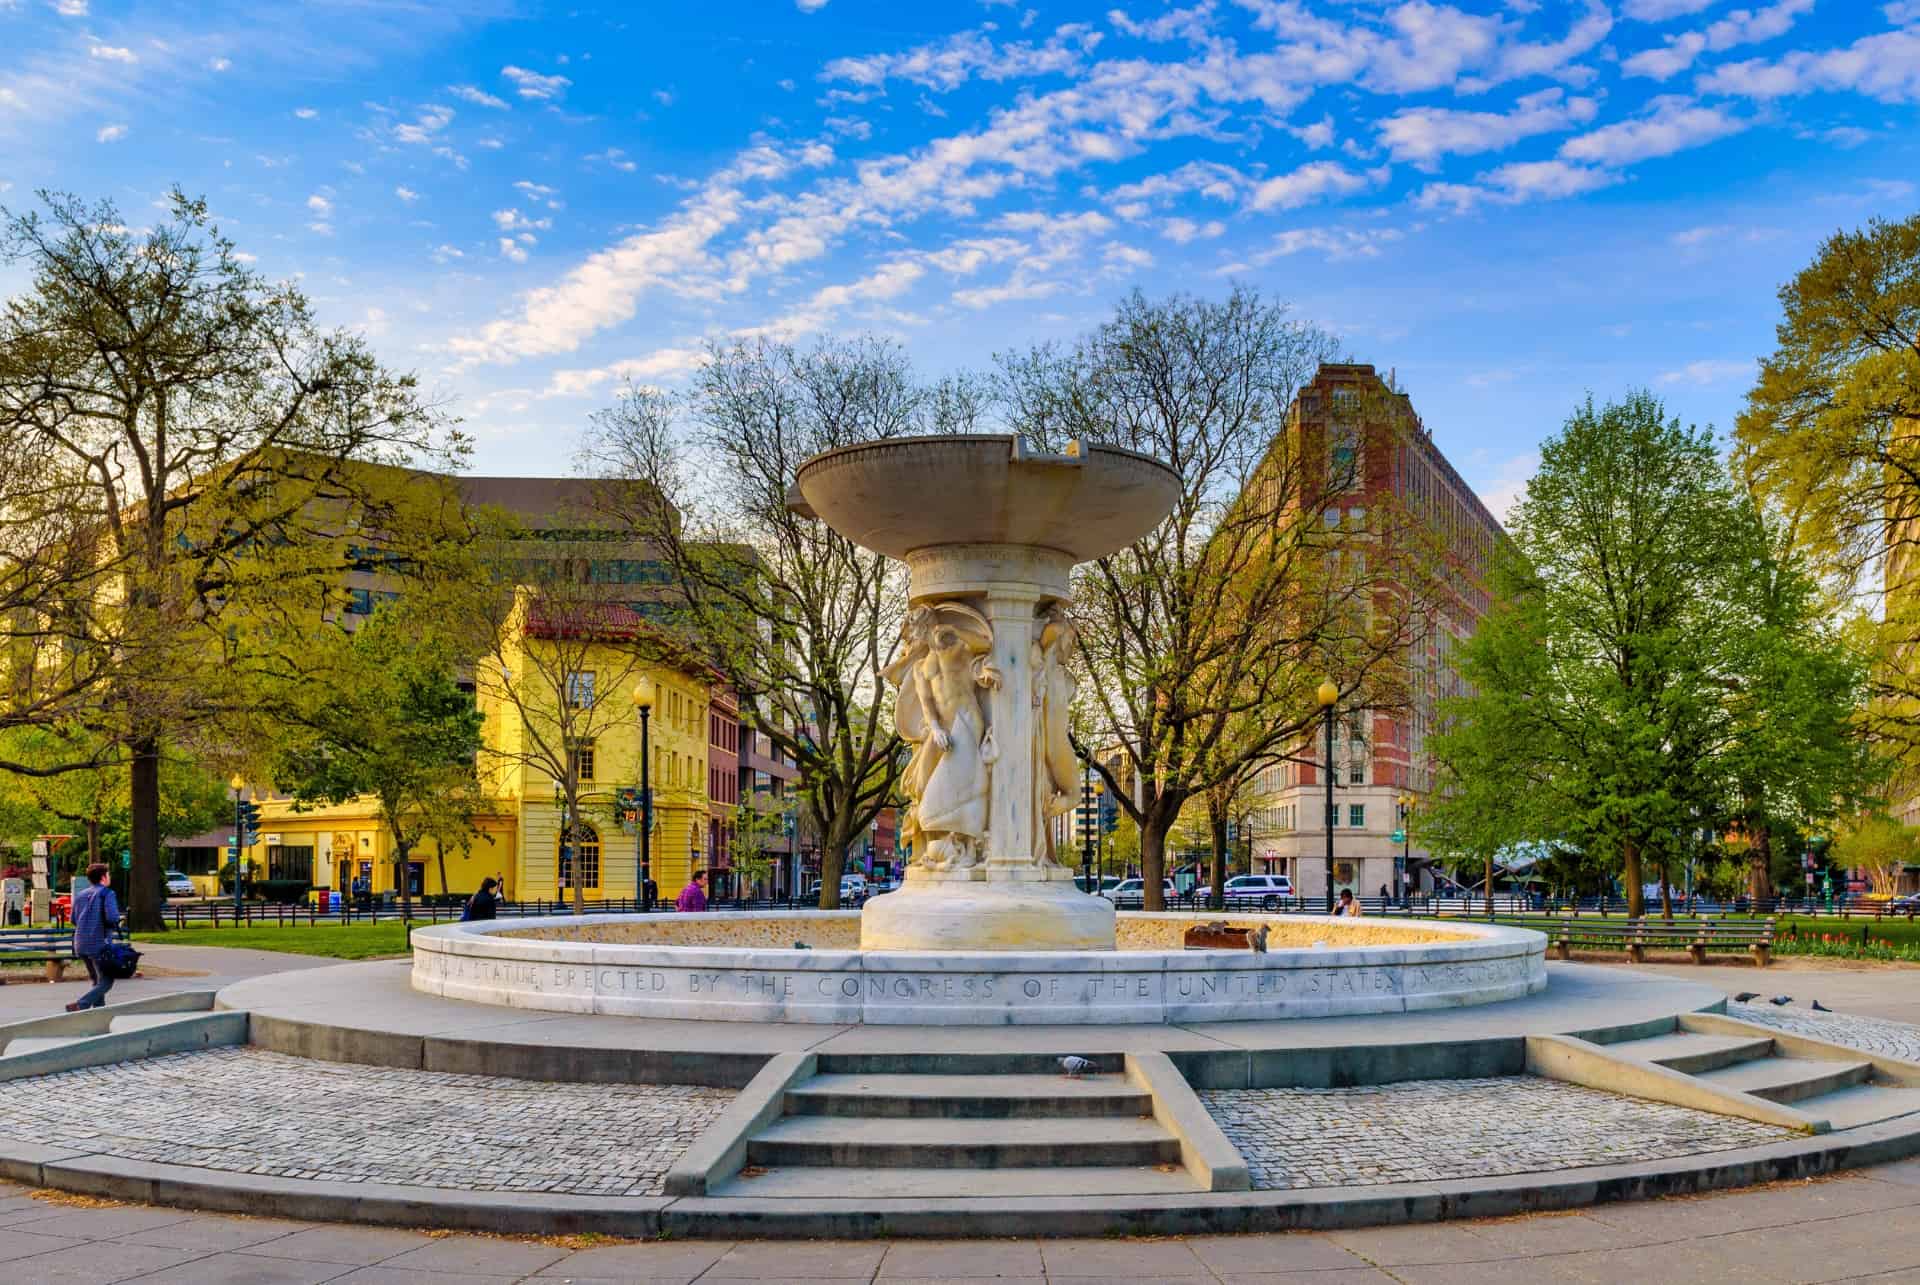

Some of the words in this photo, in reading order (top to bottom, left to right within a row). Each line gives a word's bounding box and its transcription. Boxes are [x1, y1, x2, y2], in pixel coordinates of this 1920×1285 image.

[552, 968, 667, 992] ERECTED
[688, 973, 720, 993] BY
[740, 975, 794, 996] THE
[817, 976, 994, 999] CONGRESS
[1022, 978, 1061, 999] OF
[1087, 977, 1150, 998] THE
[1177, 974, 1288, 997] UNITED
[1310, 967, 1394, 993] STATES
